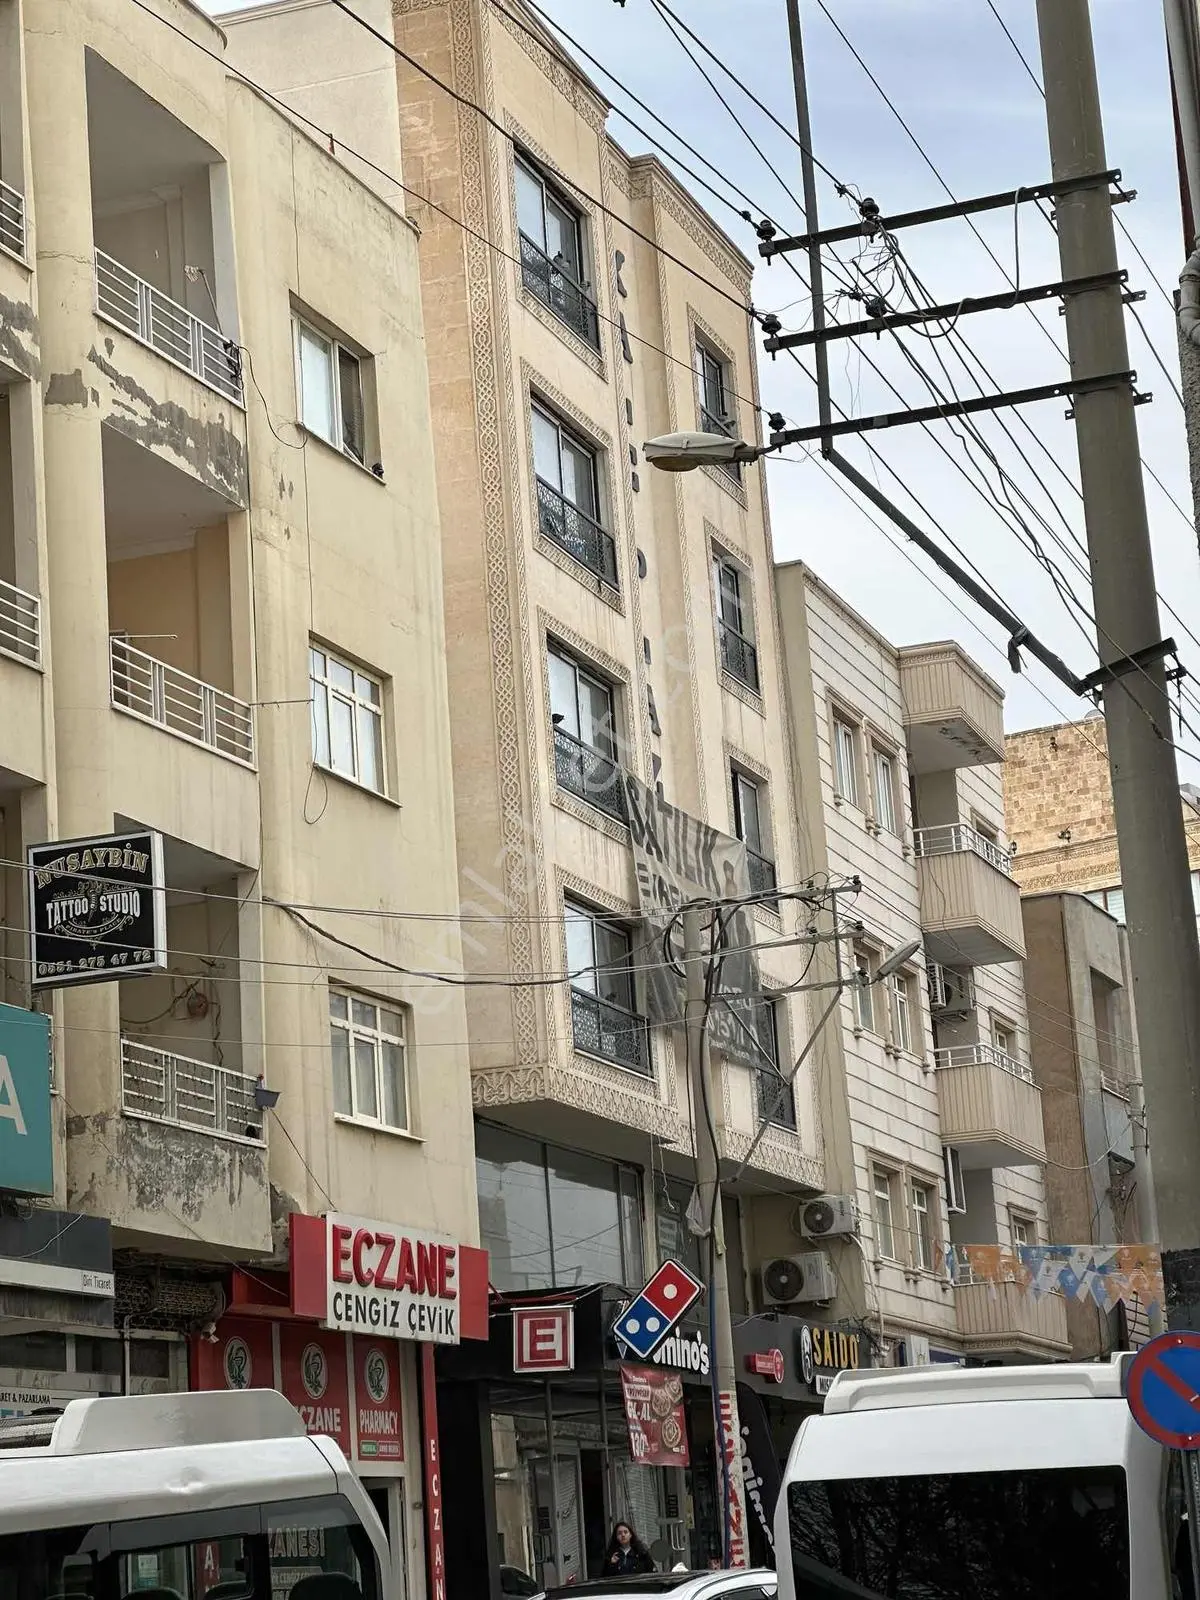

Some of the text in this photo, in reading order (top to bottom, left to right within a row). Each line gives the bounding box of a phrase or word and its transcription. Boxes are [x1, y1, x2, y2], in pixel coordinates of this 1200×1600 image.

[46, 891, 141, 929] TATTOO STUDIO
[111, 952, 128, 966] 47
[134, 949, 151, 962] 72
[332, 1223, 457, 1300] ECZANE
[407, 1303, 455, 1336] ÇEVİK
[652, 1326, 710, 1375] mino's
[296, 1405, 341, 1433] CZANE
[359, 1408, 398, 1434] PHARMACY
